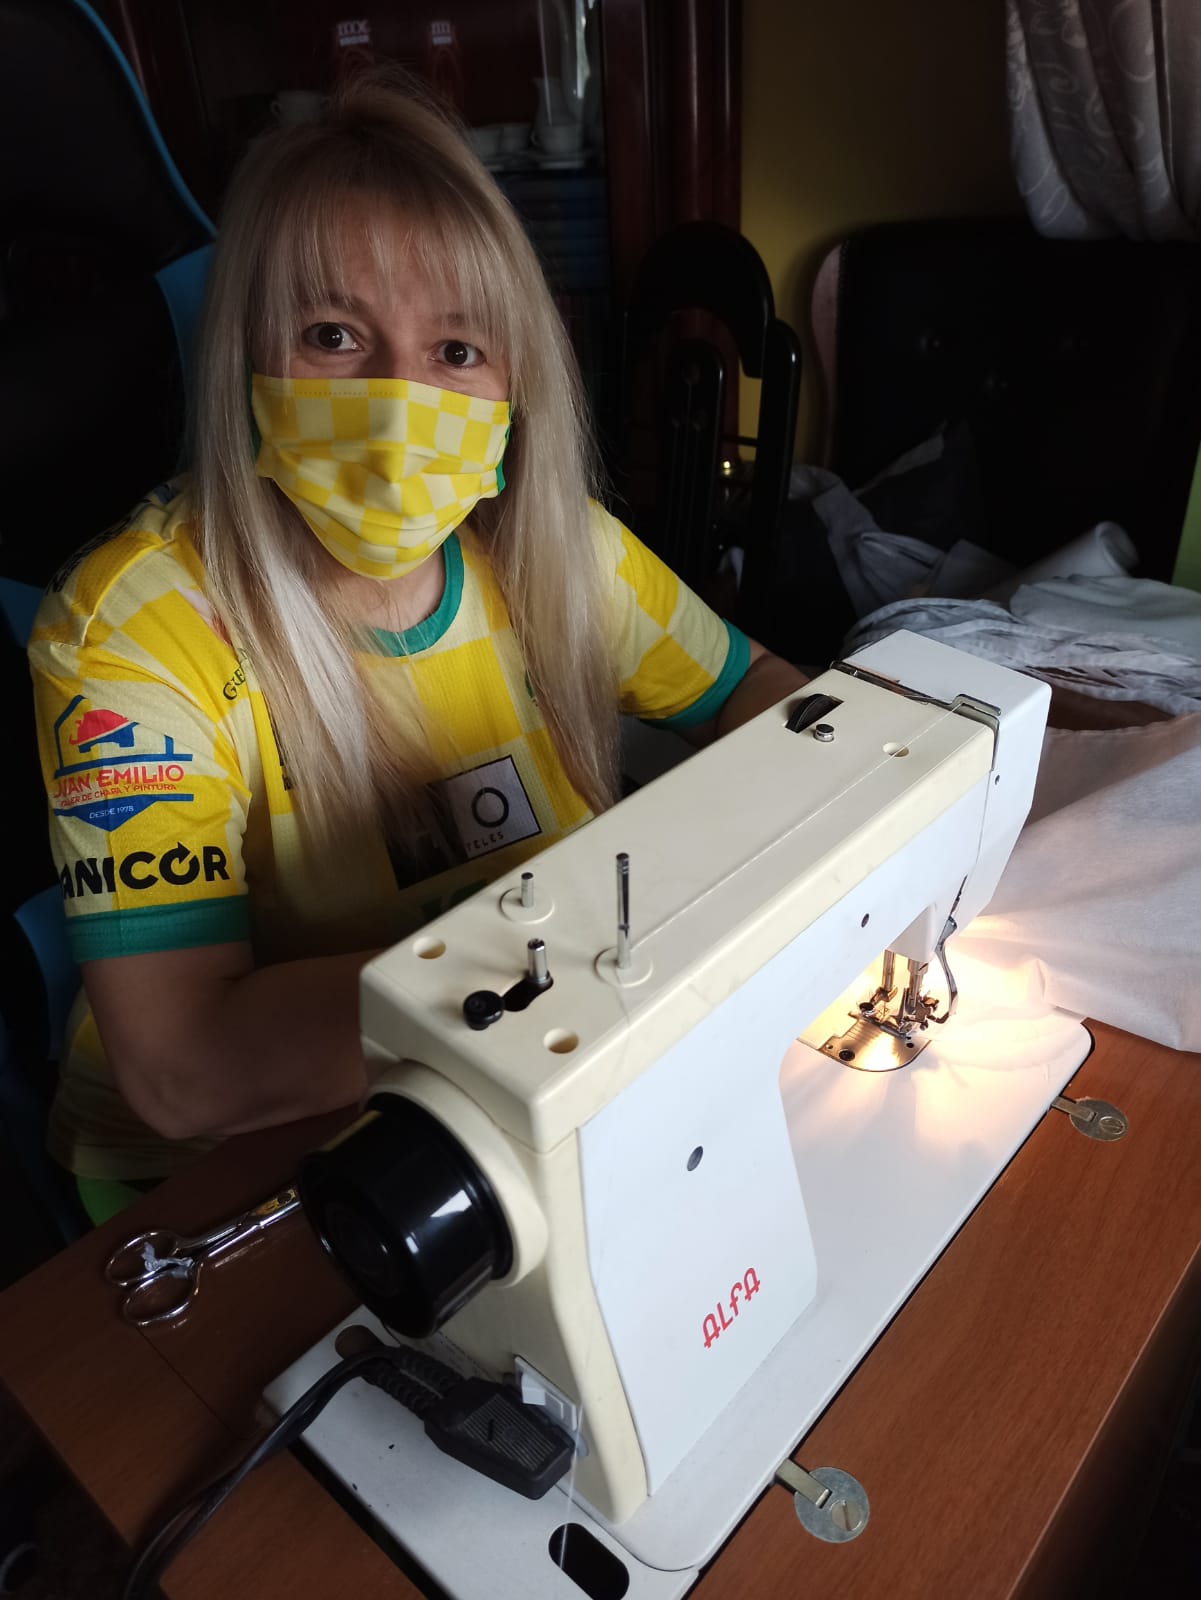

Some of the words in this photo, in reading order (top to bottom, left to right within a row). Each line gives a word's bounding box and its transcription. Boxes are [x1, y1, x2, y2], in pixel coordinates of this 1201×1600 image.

[96, 764, 184, 788] EMILIO
[81, 792, 92, 801] DE
[133, 783, 177, 792] PINTURA
[89, 808, 116, 819] DESDE
